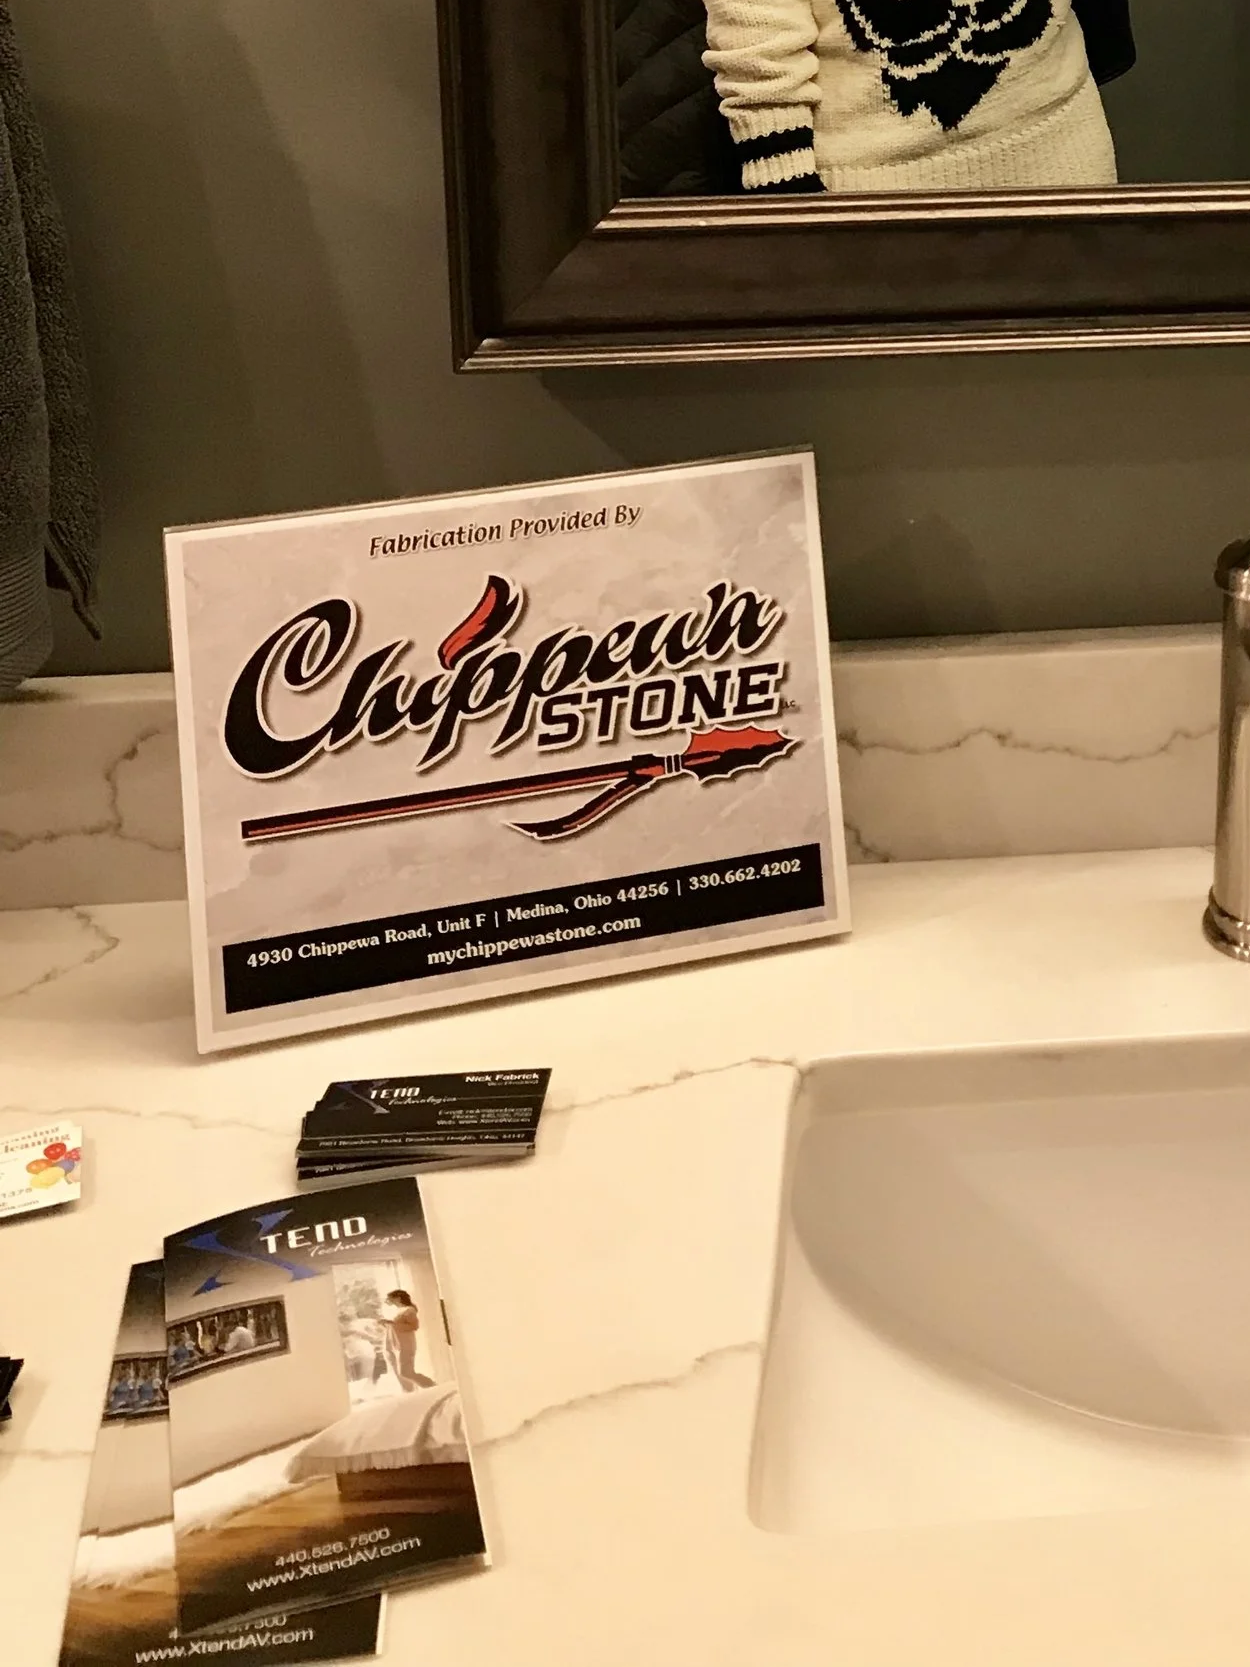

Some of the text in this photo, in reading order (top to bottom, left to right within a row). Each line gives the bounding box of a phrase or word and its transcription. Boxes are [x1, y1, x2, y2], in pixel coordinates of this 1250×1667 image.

[369, 503, 641, 556] Fabrication Provided By
[224, 577, 786, 777] Chippewa
[537, 658, 790, 750] STONE
[246, 947, 293, 968] 4930
[297, 934, 380, 959] Chippewa
[384, 924, 433, 945] Road,
[437, 917, 471, 934] Unit
[475, 913, 487, 927] F
[505, 902, 570, 924] Medina,
[573, 893, 612, 910] Ohio
[616, 881, 669, 903] 44256
[688, 858, 802, 891] 330.662.4202
[427, 915, 642, 966] mychippewastone.com
[465, 1073, 492, 1083] Nick
[247, 1535, 422, 1593] www.XtendAV.com
[135, 1628, 315, 1665] www.XtendAV.com
